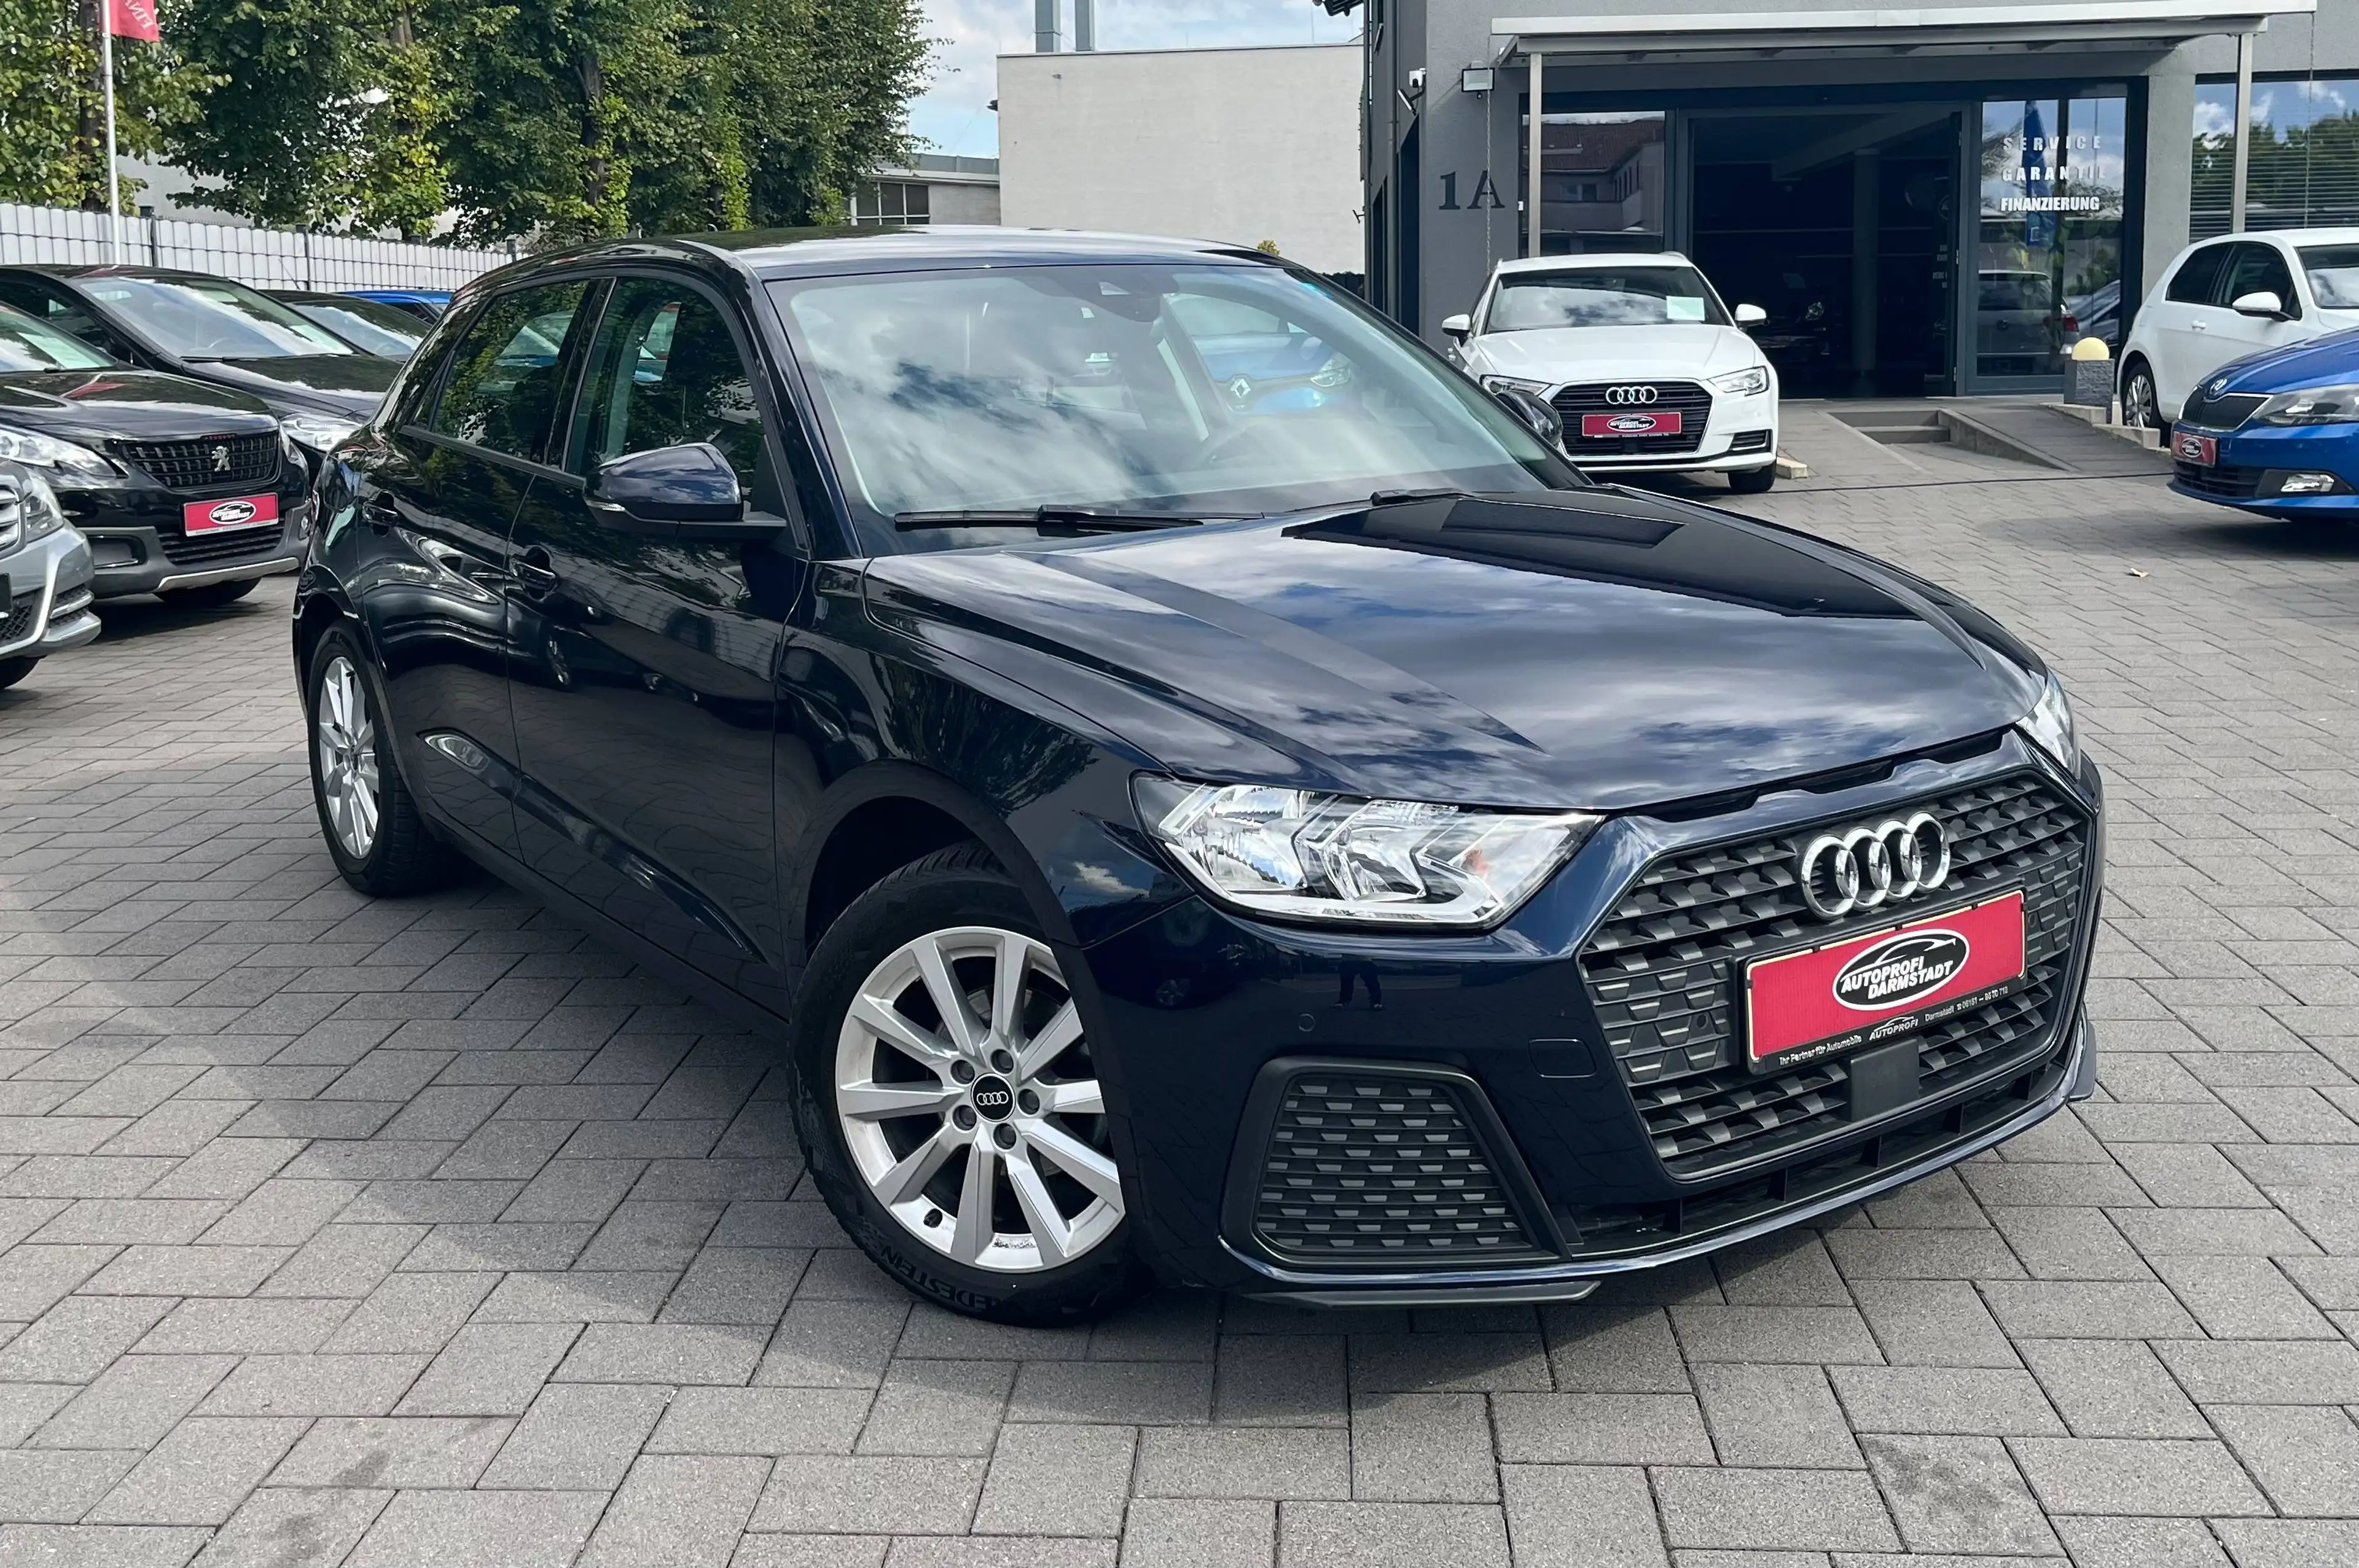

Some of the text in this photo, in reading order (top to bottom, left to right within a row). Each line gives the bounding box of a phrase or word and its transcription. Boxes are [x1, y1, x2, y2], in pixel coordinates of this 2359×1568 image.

[2003, 136, 2102, 151] SERVICE
[1439, 170, 1506, 210] 1A
[2002, 166, 2107, 182] GARANTIE
[2000, 196, 2100, 211] FINANZIERUNG
[1841, 956, 1925, 993] AUTOPROFI
[1868, 960, 1954, 999] DARMSTADT
[1779, 1056, 1790, 1066] Ihr
[1790, 1049, 1815, 1063] Partner
[1826, 1034, 1863, 1053] Automobile
[1869, 1018, 1919, 1041] AUTOPROFI
[1925, 1005, 1954, 1021] Darmstadt
